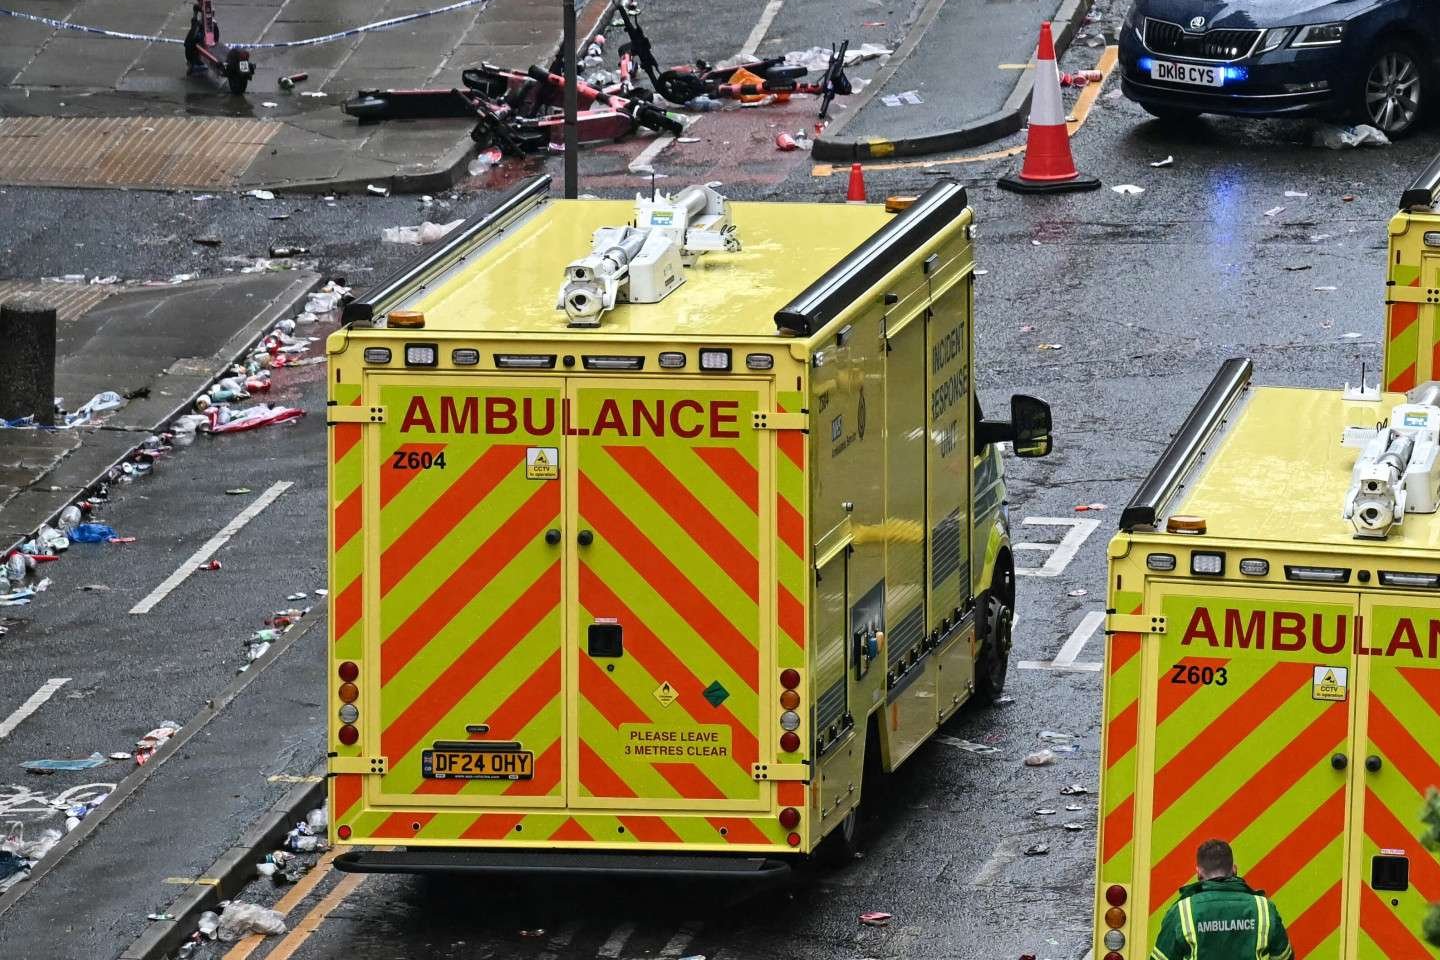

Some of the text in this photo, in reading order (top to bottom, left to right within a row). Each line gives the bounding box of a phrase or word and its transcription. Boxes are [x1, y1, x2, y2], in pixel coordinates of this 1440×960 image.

[1158, 63, 1214, 83] DK18 CYS
[932, 320, 965, 376] INCIDENT
[931, 365, 969, 421] RESPONSE
[400, 395, 741, 439] AMBULANCE
[392, 451, 447, 470] Z604
[1171, 664, 1228, 686] Z603
[630, 731, 719, 742] PLEASE LEAVE
[625, 745, 727, 756] 3 METRES CLEAR
[435, 754, 529, 772] DF24 OHY
[1198, 919, 1255, 933] AMBULANCE
